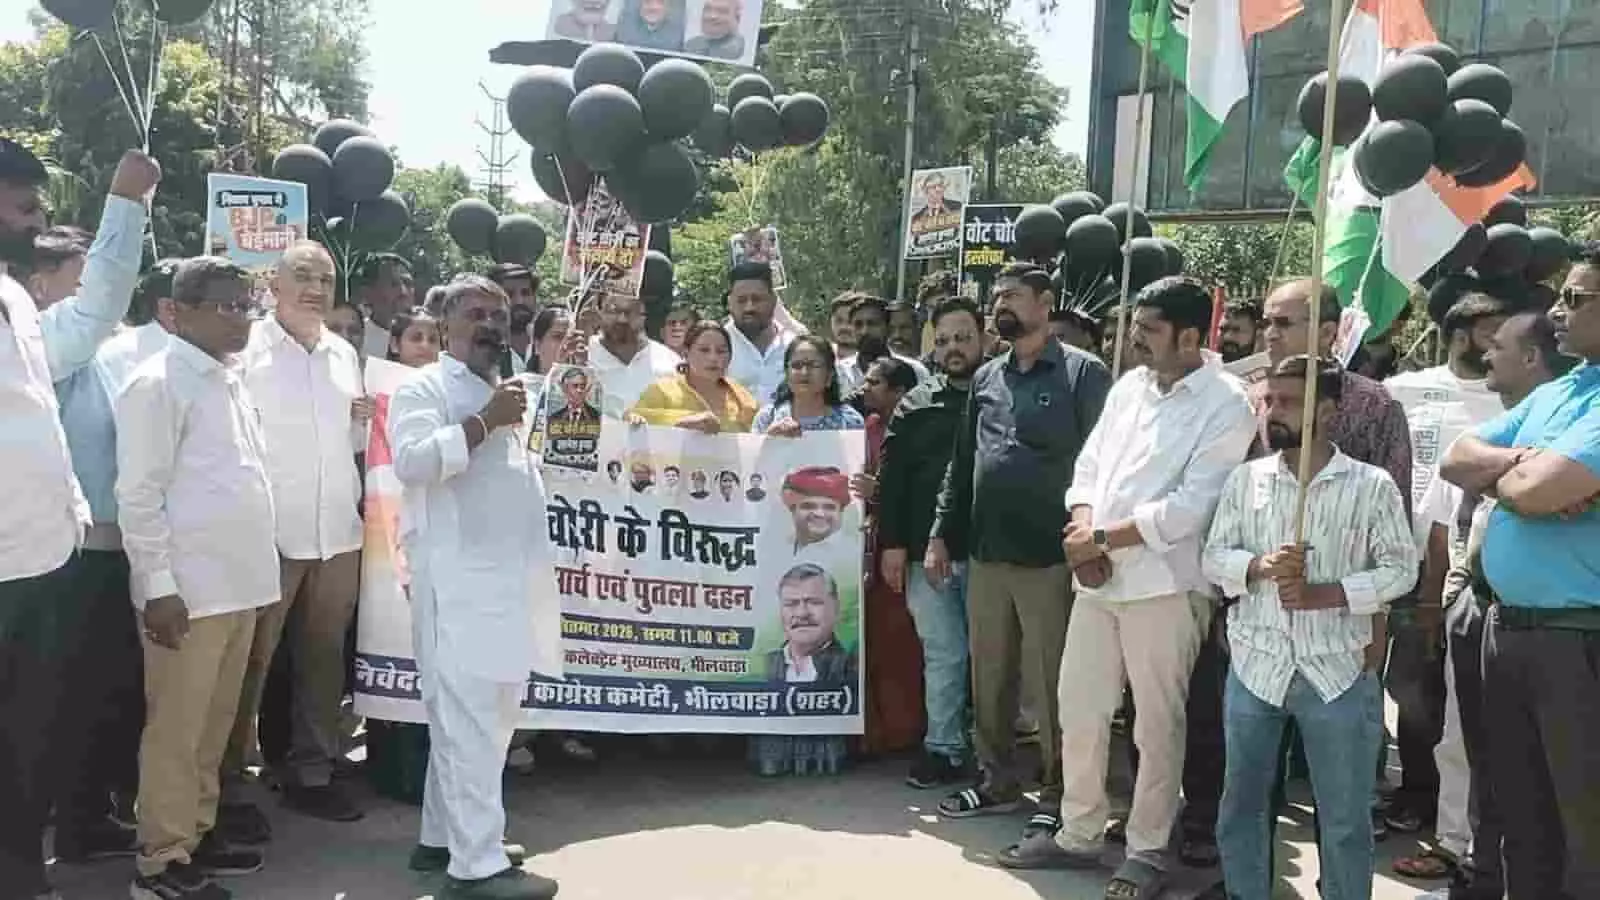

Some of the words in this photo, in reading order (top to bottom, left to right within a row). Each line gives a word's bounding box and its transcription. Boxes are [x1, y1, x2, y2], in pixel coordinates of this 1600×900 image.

[229, 206, 275, 229] BJP
[963, 215, 991, 243] वोट
[546, 494, 609, 553] चोरी
[614, 504, 651, 558] के
[657, 508, 761, 572] विरुद्ध
[594, 568, 629, 602] एवं
[632, 576, 698, 615] पुतला
[702, 583, 753, 611] दहन
[642, 627, 676, 643] समय
[716, 629, 740, 647] बजे
[354, 657, 423, 692] निवेद
[533, 678, 603, 705] कांग्रेस
[605, 682, 680, 712] कमेटी,
[684, 685, 781, 716] भीलवाड़ा
[785, 685, 852, 716] (शहर)
